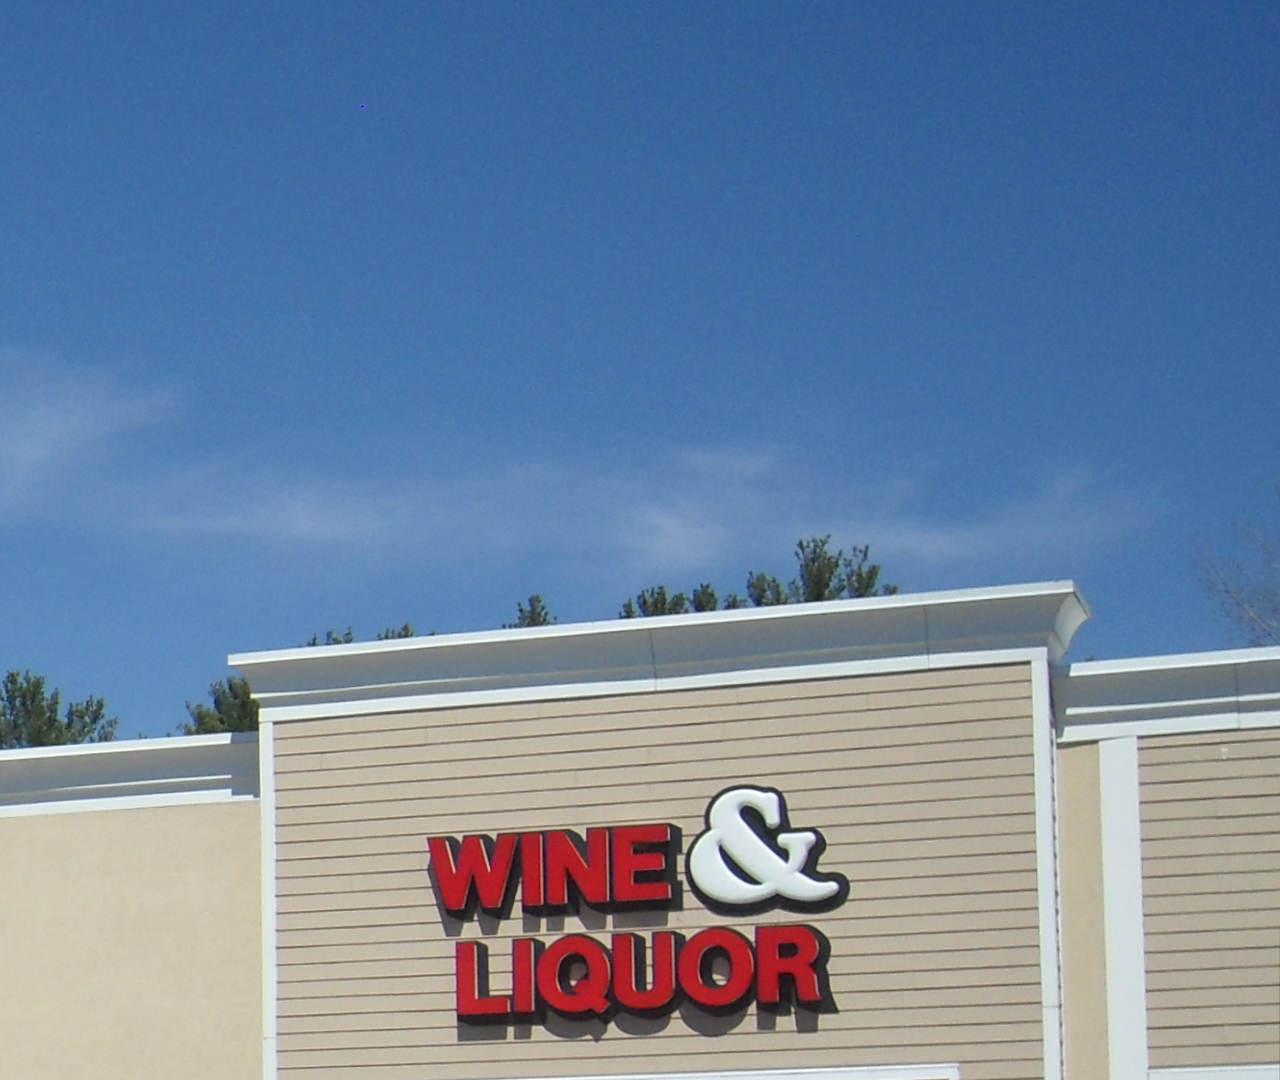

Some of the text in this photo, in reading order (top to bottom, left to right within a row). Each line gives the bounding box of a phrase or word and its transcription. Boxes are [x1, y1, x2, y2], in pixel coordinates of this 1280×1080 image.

[427, 786, 843, 911] WINE &
[456, 925, 823, 1016] LIQUOR
